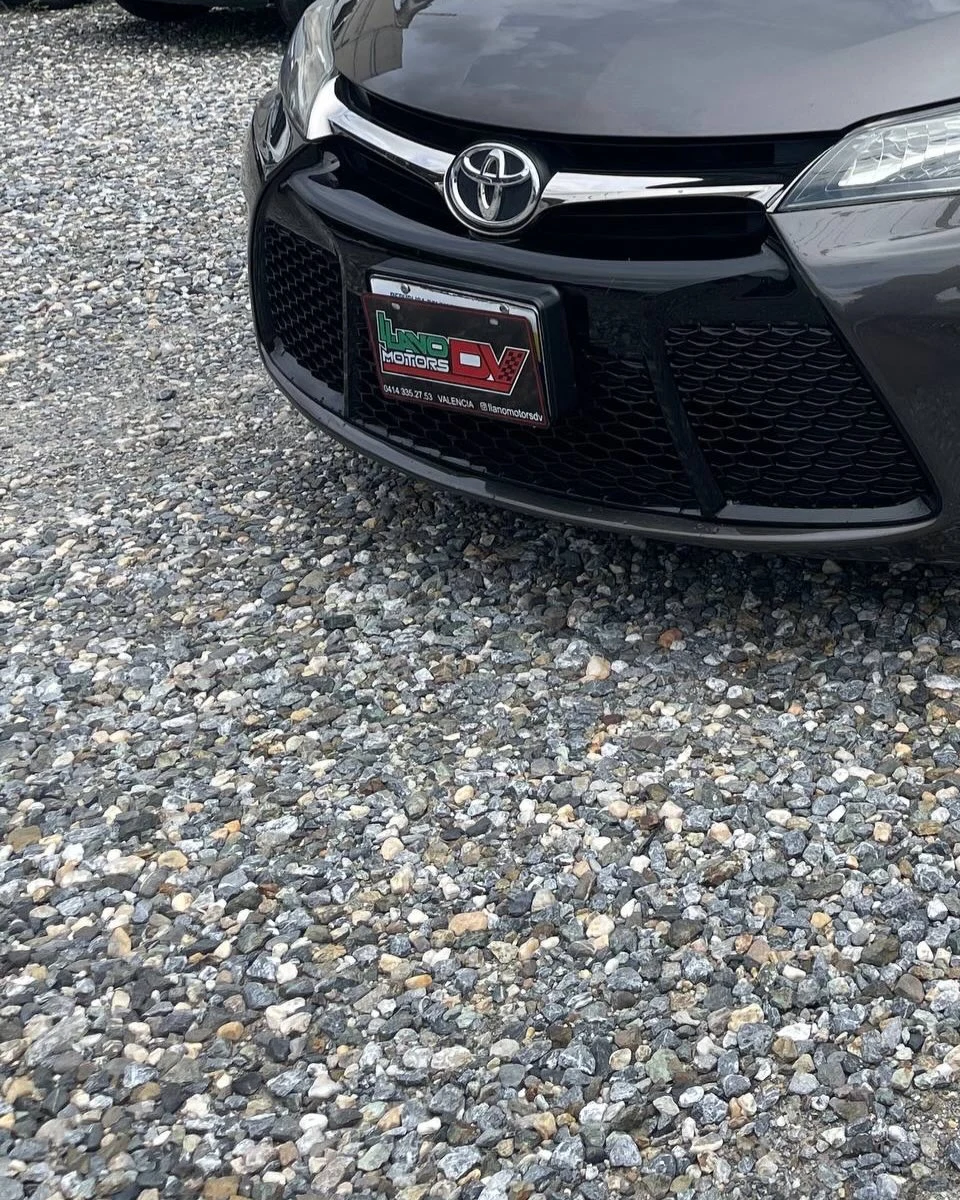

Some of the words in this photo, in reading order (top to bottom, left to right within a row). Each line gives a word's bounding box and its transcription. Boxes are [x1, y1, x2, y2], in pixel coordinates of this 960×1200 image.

[375, 310, 449, 358] LLANO
[382, 348, 449, 373] MOTORS
[449, 337, 529, 383] DV
[383, 384, 400, 395] 0414
[437, 394, 475, 409] VALENCIA
